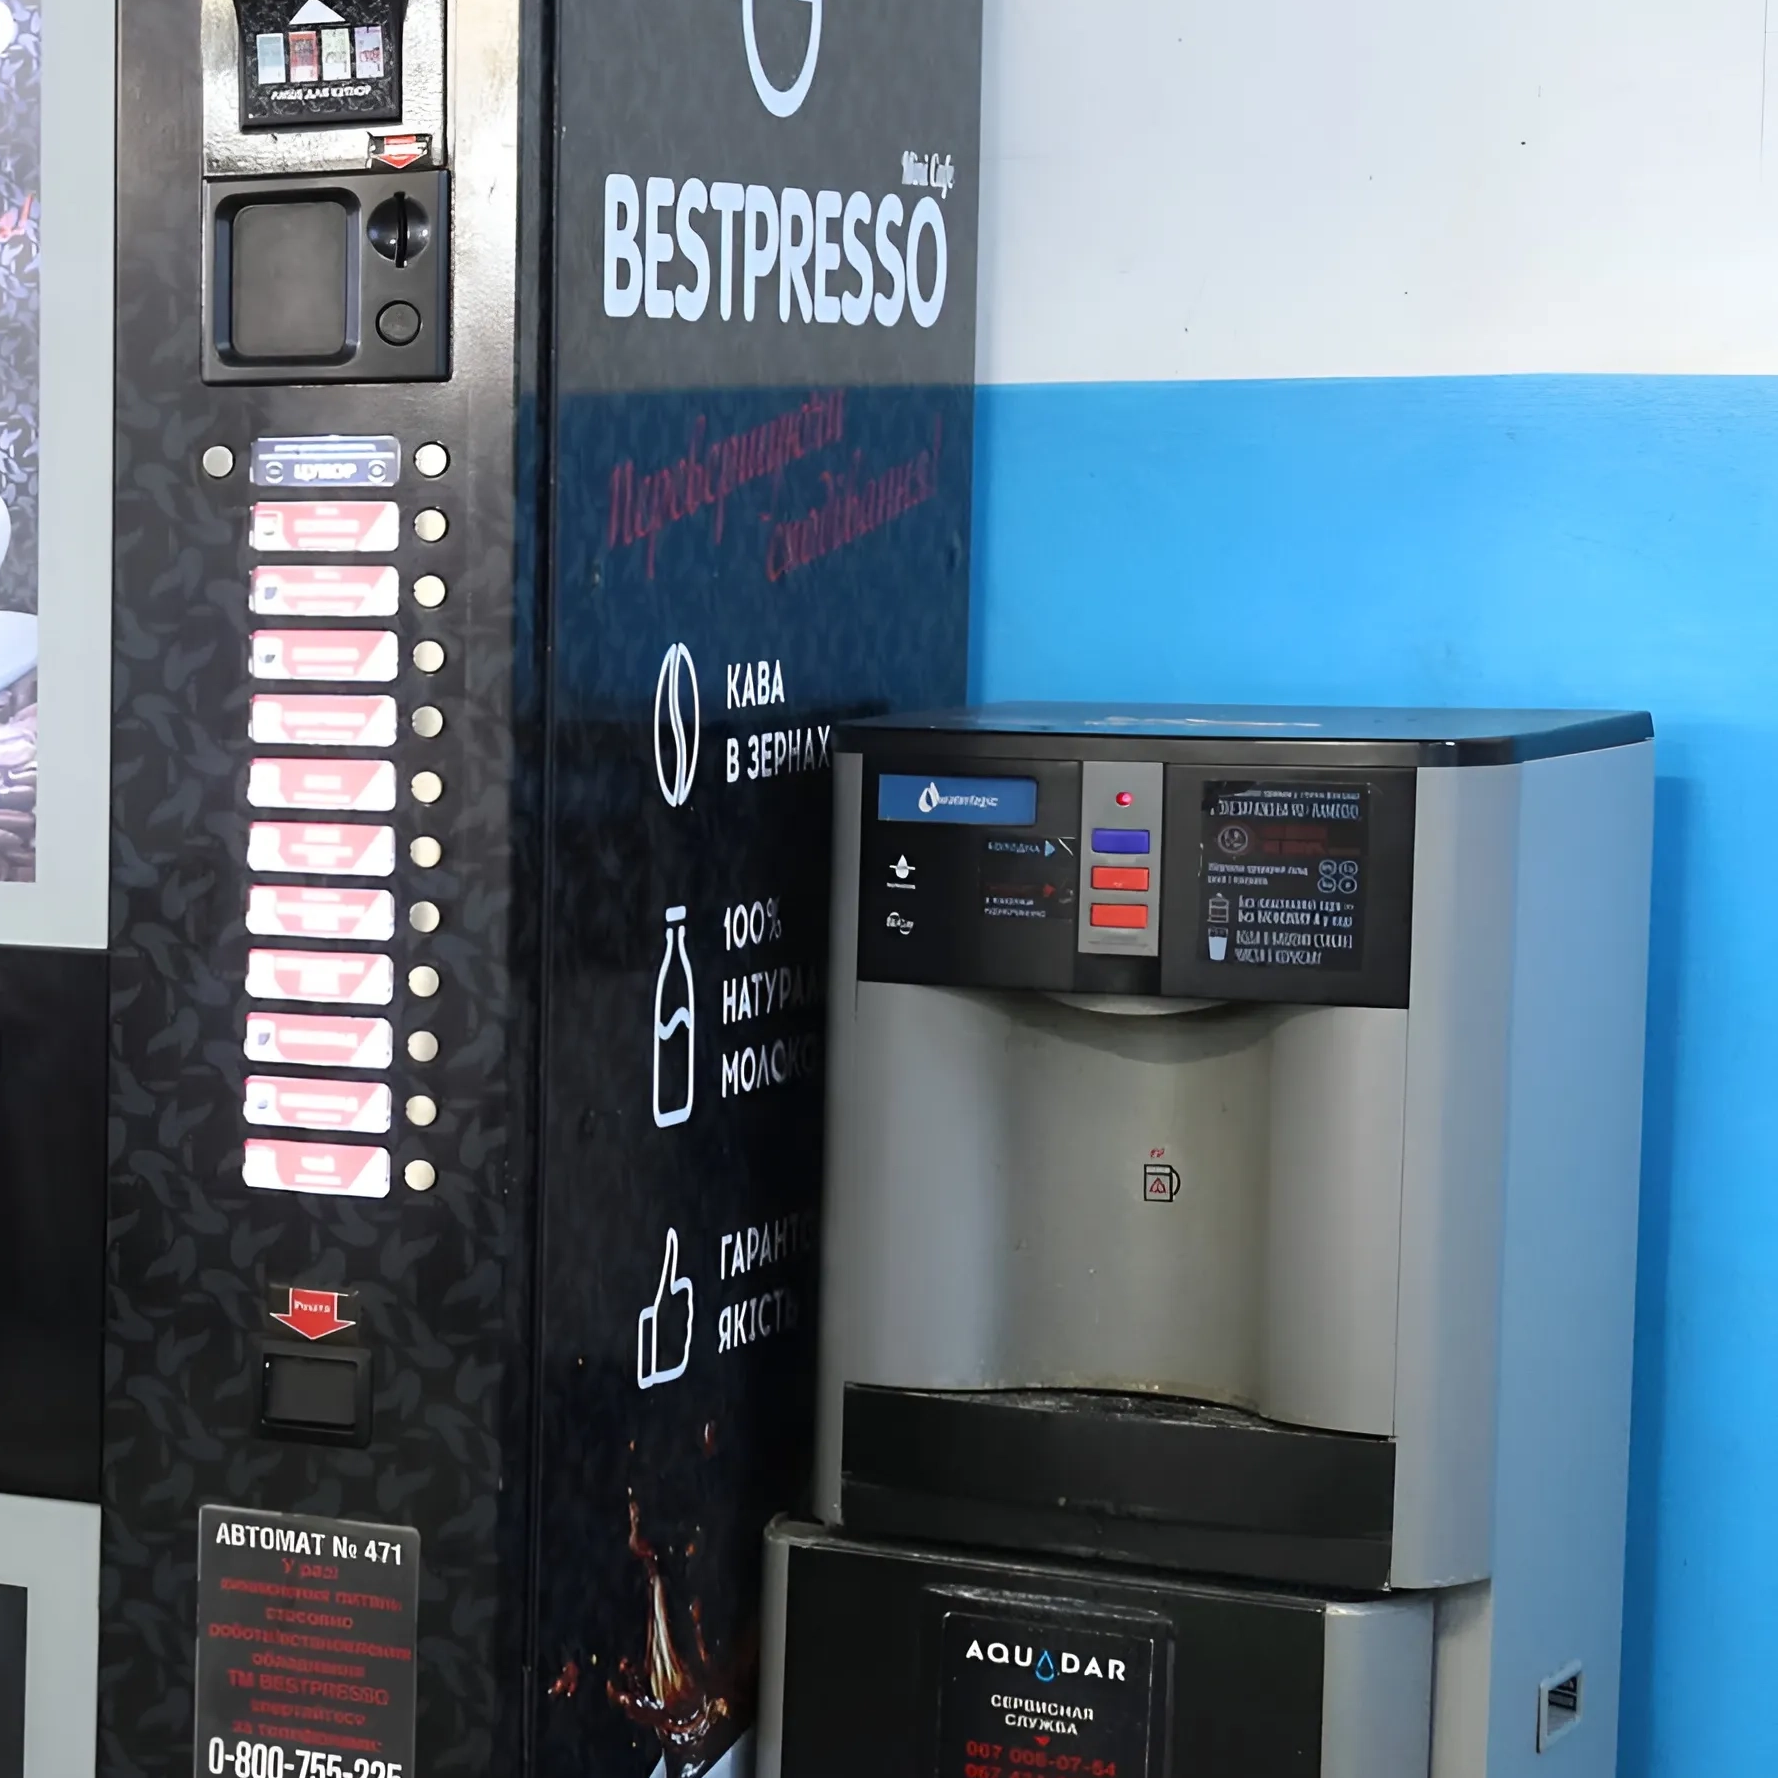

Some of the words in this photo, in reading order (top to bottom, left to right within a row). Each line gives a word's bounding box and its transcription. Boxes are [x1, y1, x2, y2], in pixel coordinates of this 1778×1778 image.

[603, 173, 947, 328] BESTPRESSO
[726, 659, 785, 710] КАВА
[726, 737, 740, 784] В
[746, 725, 831, 780] ЗЕРНАХ
[723, 896, 782, 951] 100%
[215, 1521, 326, 1556] АВТОМАТ
[332, 1535, 358, 1560] №
[364, 1540, 402, 1566] 471
